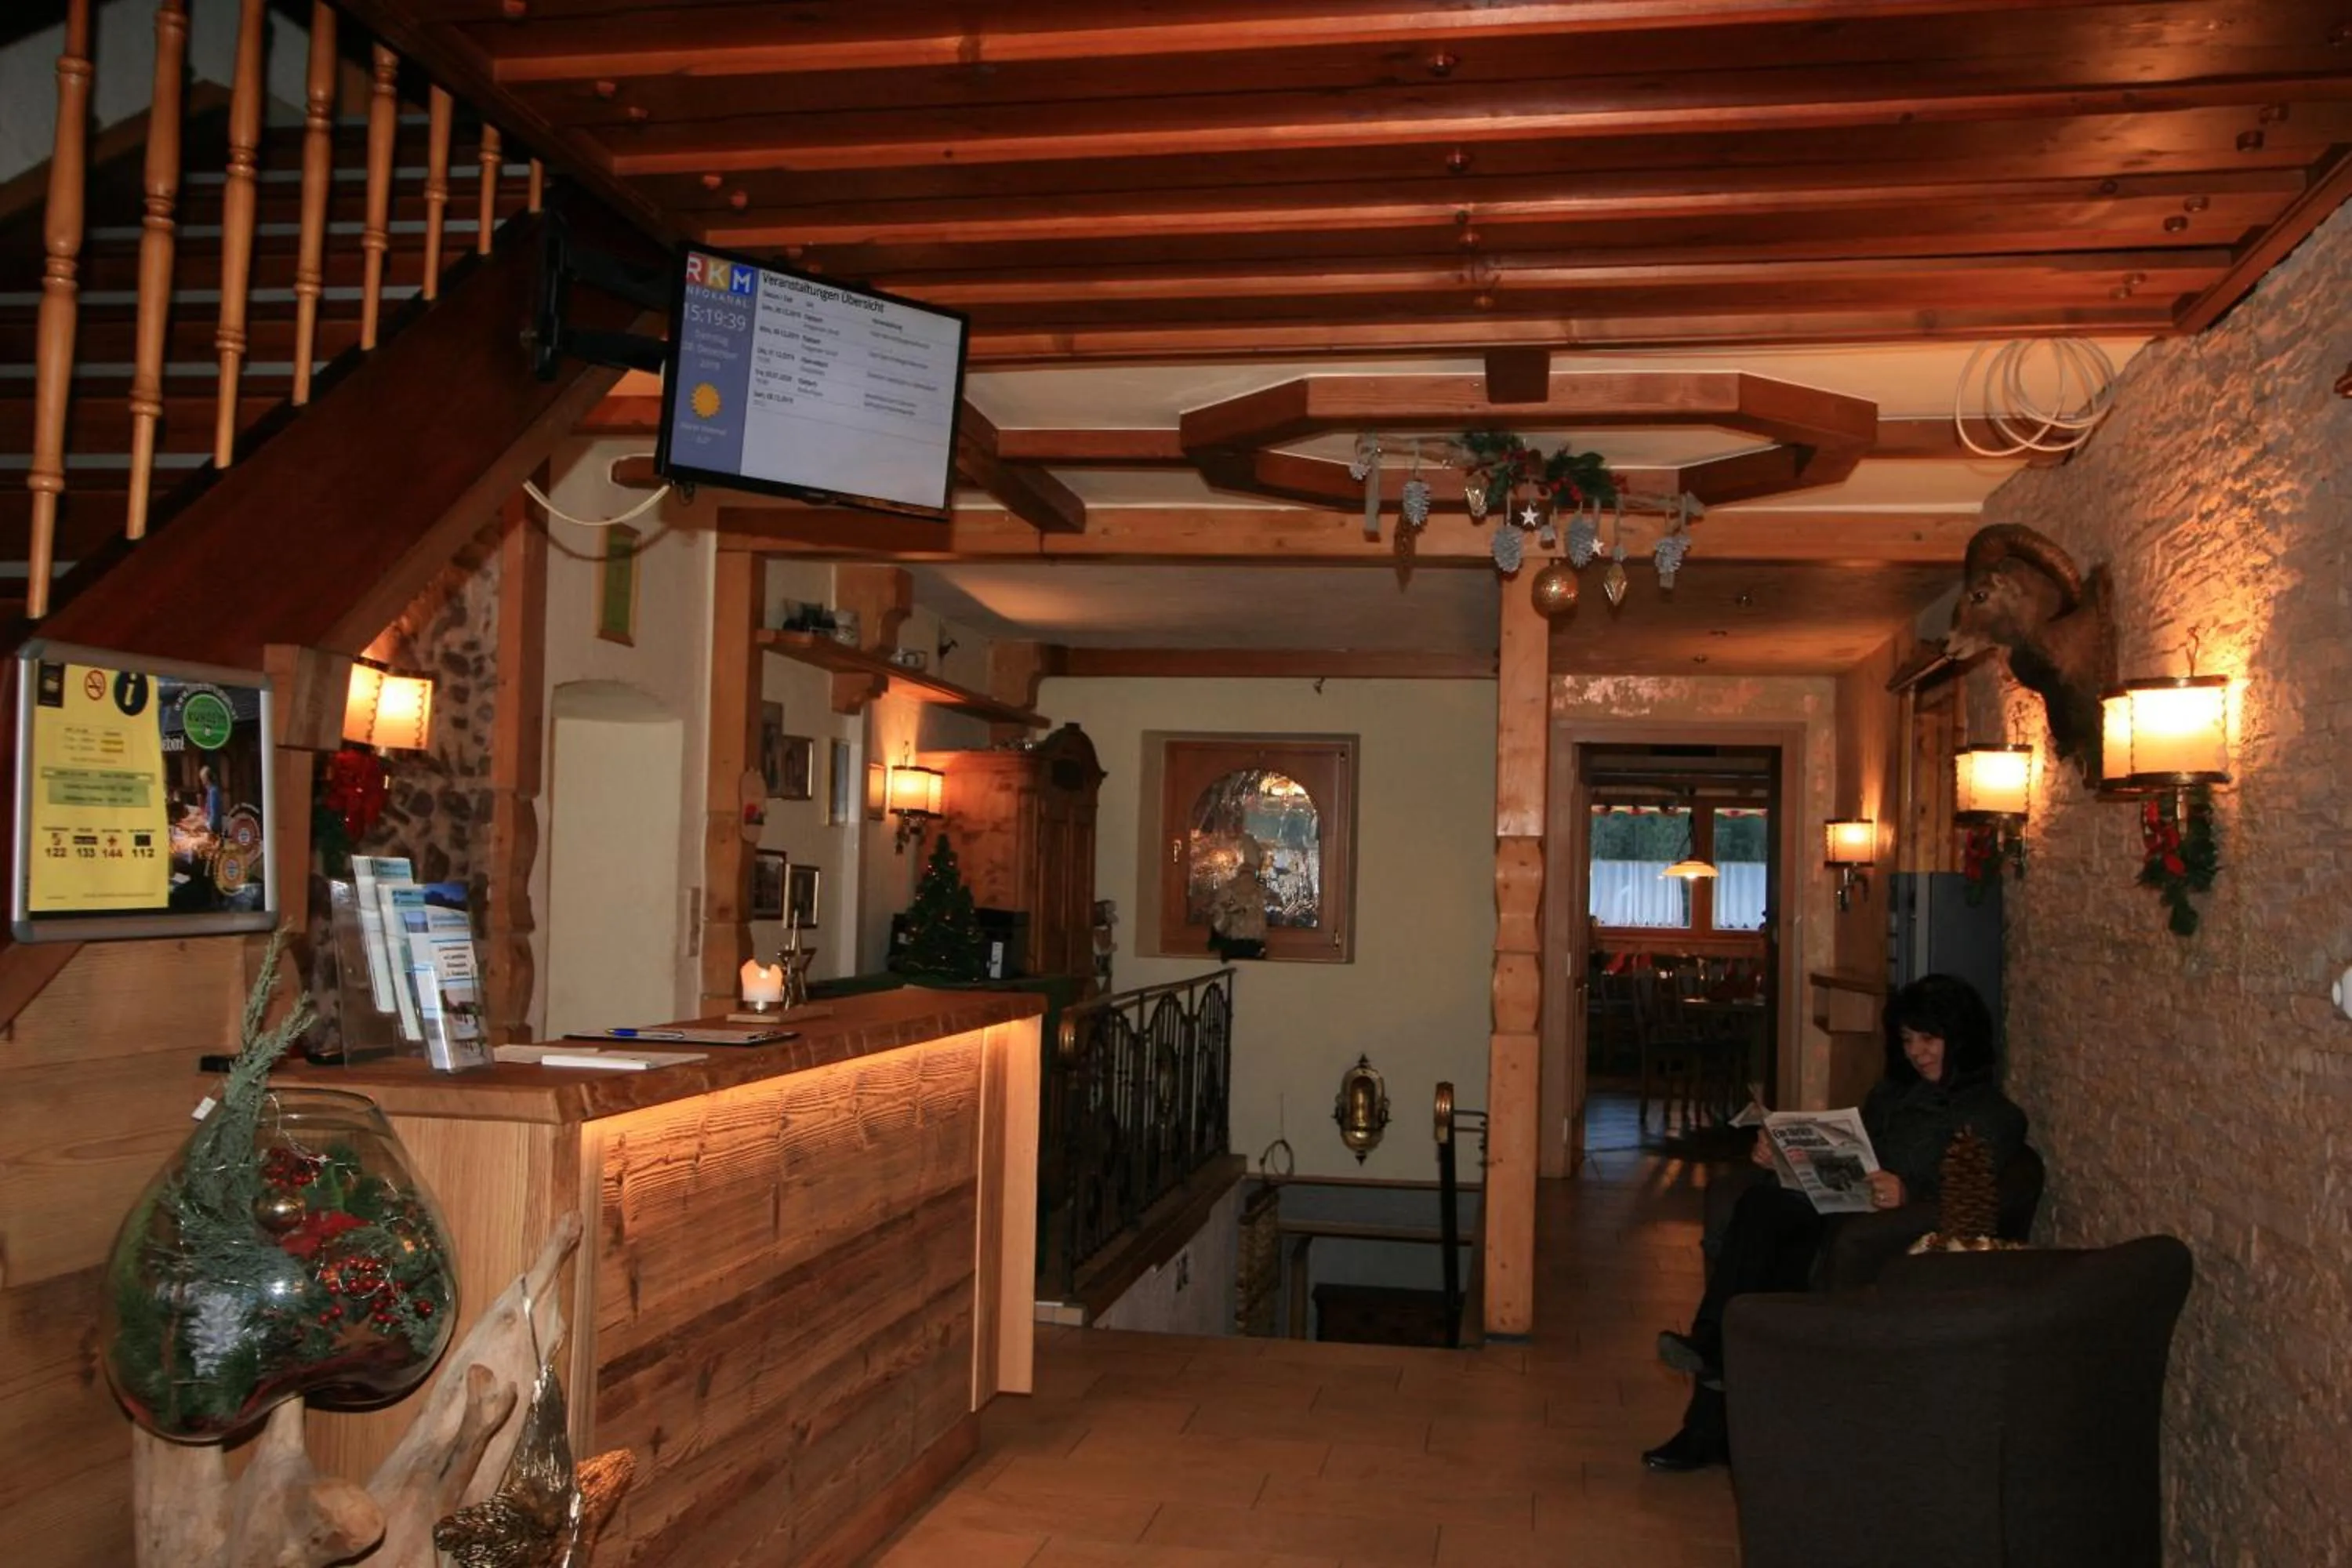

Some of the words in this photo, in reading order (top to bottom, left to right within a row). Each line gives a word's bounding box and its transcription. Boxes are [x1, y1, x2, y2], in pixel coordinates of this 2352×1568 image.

[688, 256, 753, 294] RKM
[687, 285, 750, 309] NFOKANAL
[762, 271, 840, 303] Veranstaltungen
[840, 290, 885, 314] Übersicht
[45, 847, 68, 858] 122
[76, 847, 96, 858] 133
[103, 848, 124, 859] 144
[132, 847, 156, 859] 112
